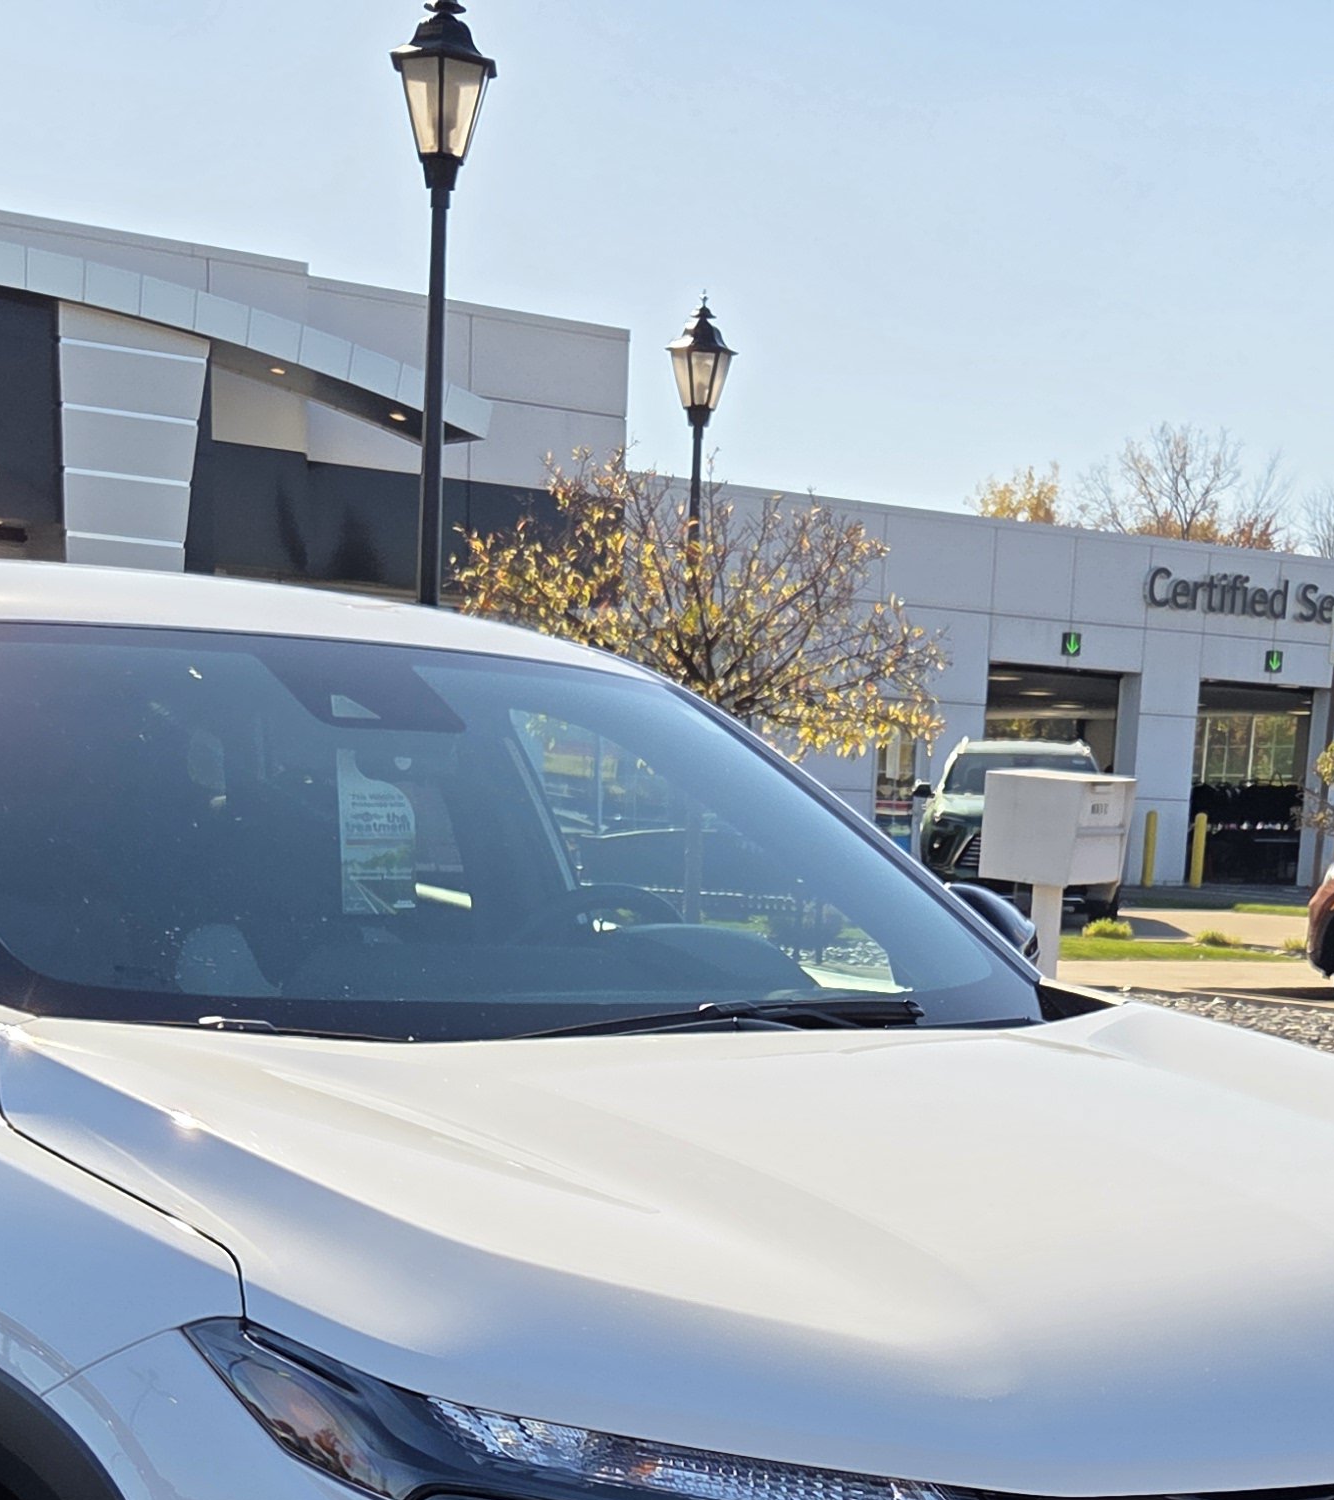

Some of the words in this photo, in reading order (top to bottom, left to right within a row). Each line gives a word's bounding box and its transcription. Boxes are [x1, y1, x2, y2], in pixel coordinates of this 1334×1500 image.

[1145, 567, 1290, 620] Certified
[387, 812, 408, 824] the
[345, 821, 411, 833] treatment
